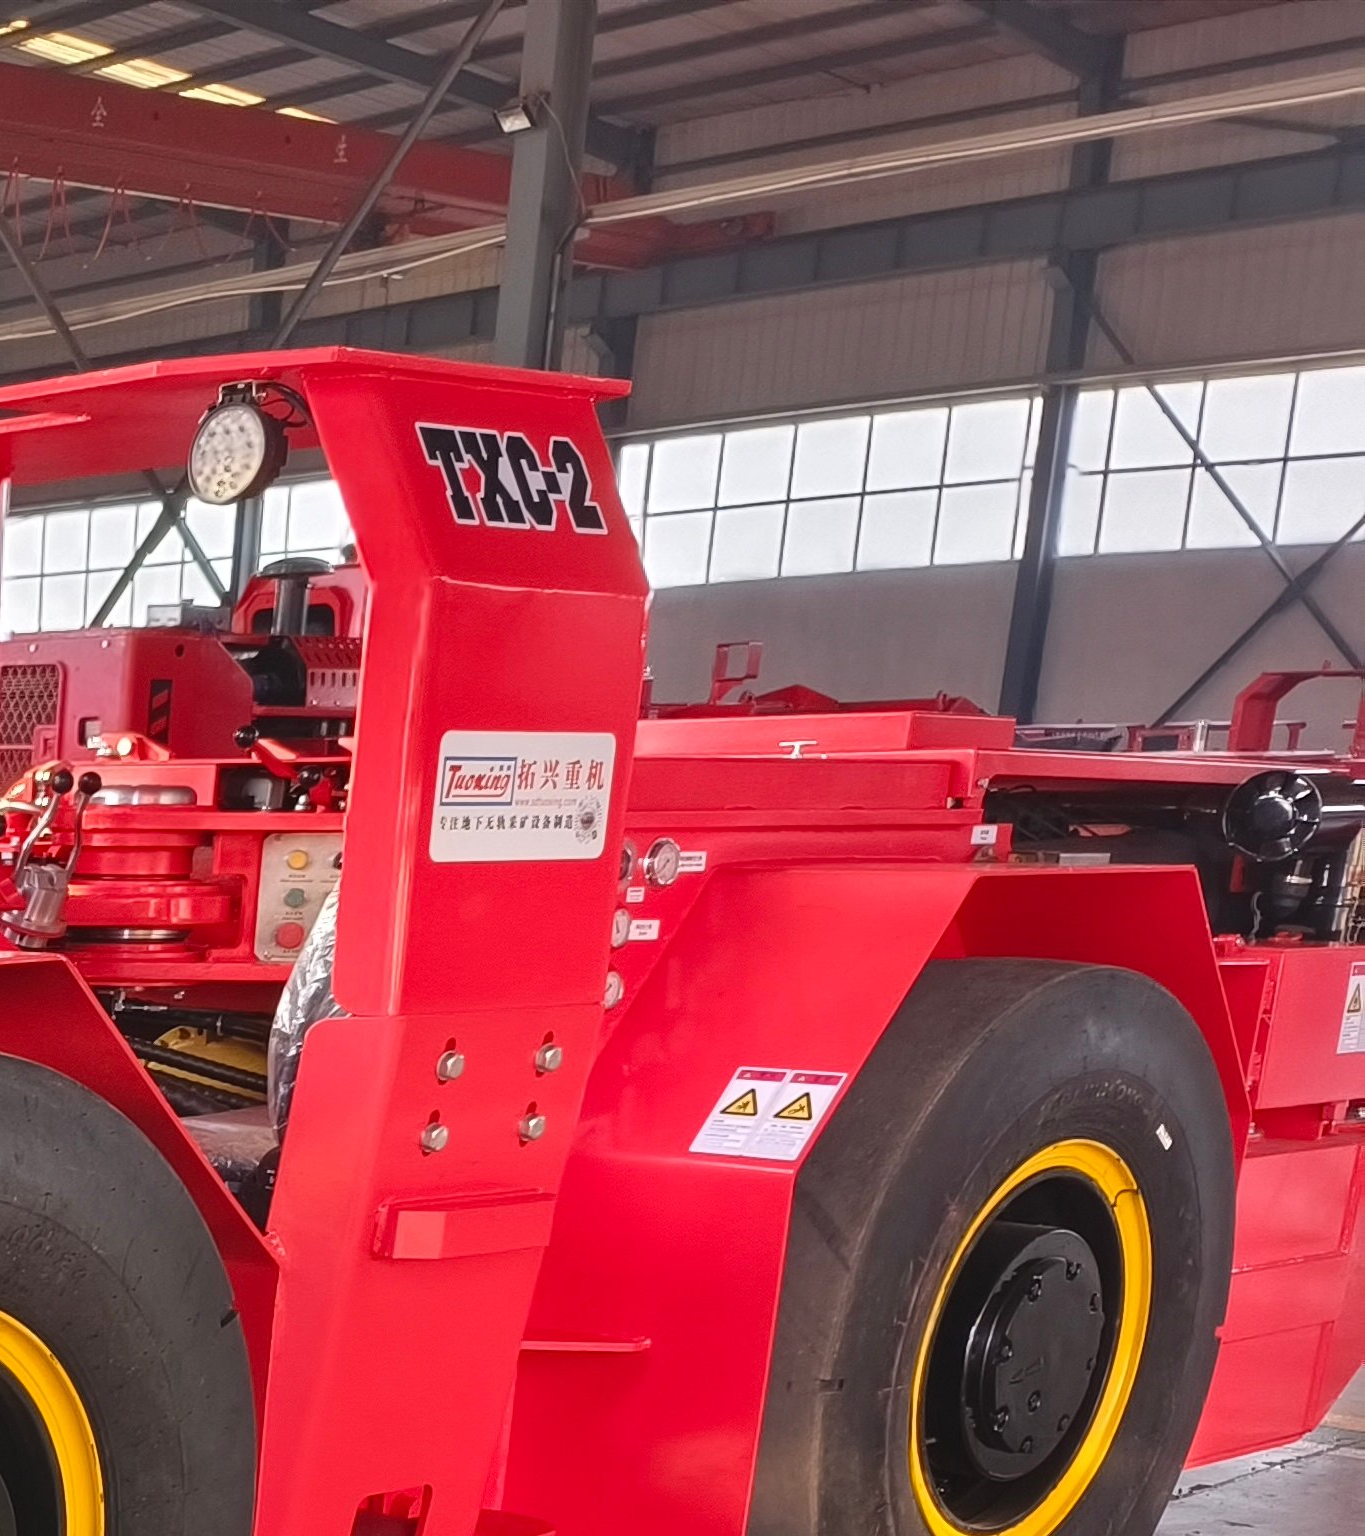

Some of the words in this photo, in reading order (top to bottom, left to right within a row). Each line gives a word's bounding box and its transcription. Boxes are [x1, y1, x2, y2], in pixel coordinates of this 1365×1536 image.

[416, 423, 609, 535] TXC-2
[517, 758, 605, 791] 拓兴重机
